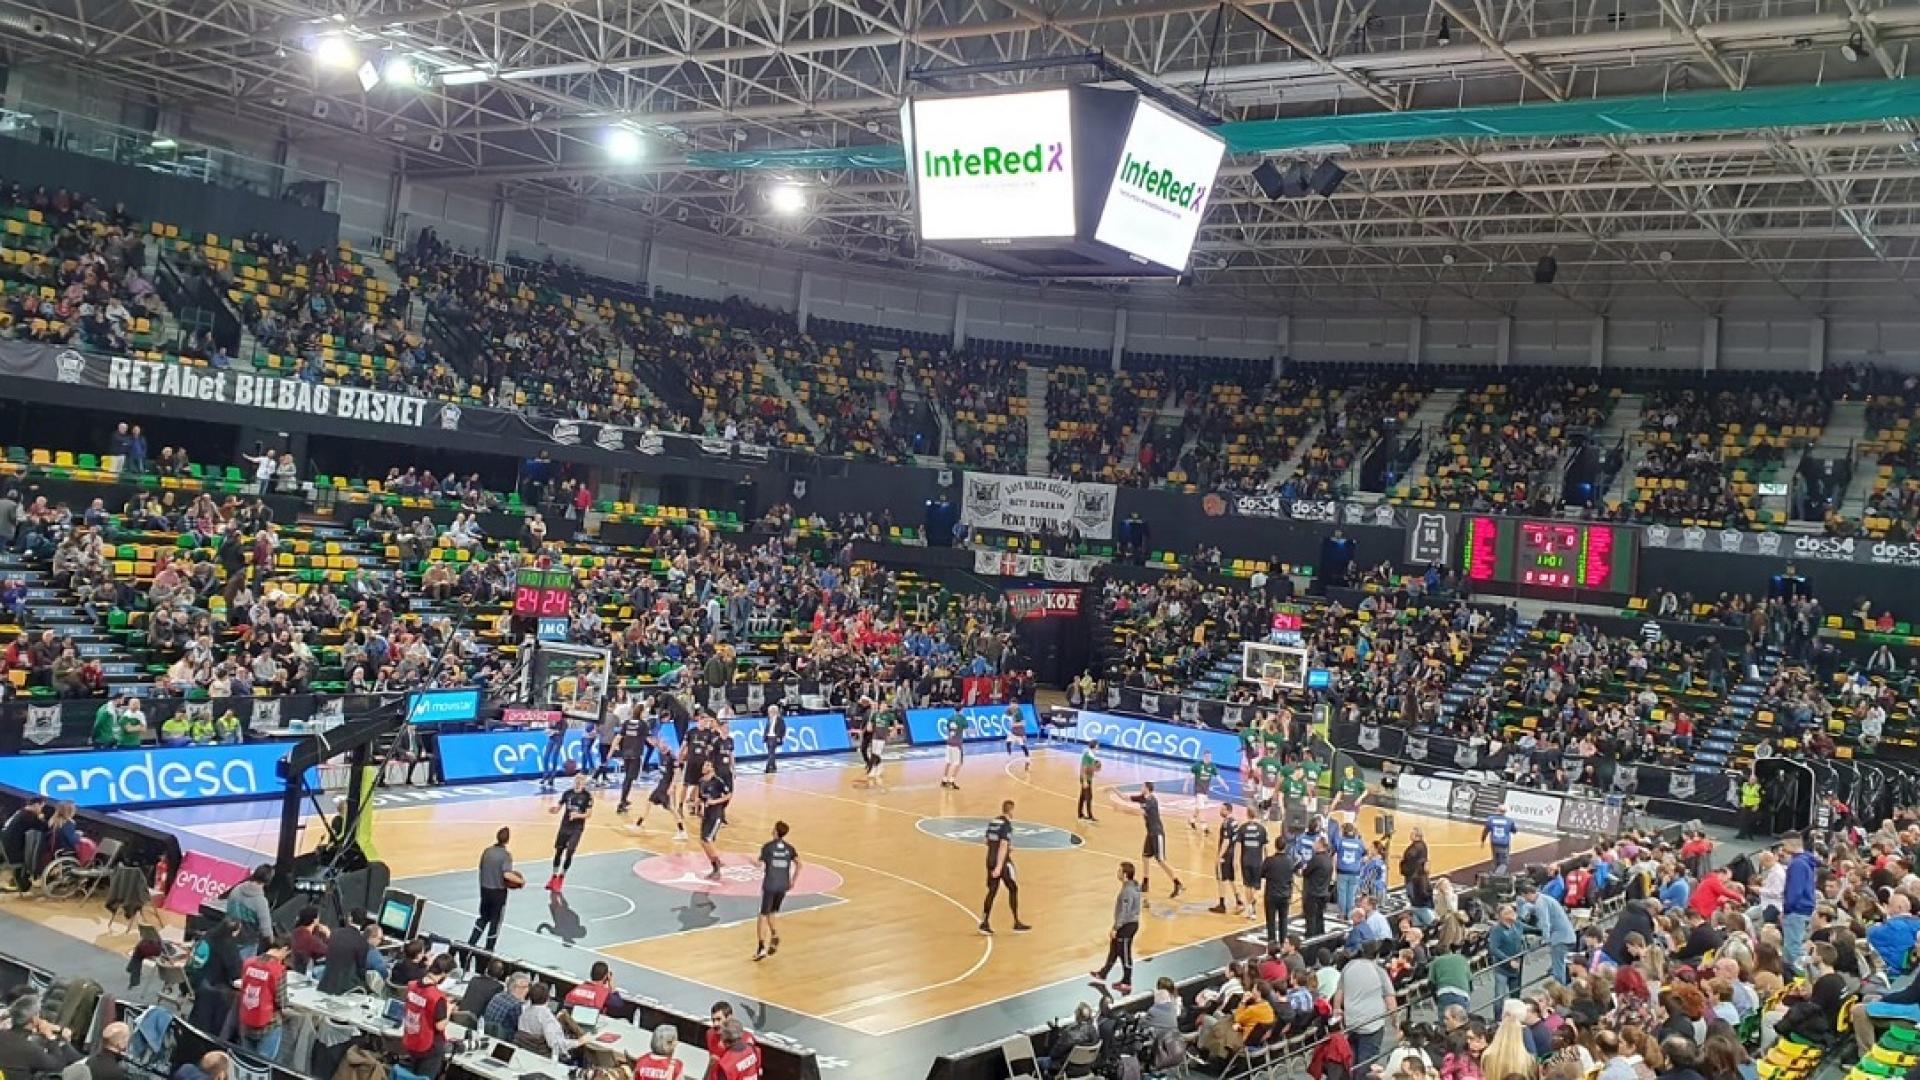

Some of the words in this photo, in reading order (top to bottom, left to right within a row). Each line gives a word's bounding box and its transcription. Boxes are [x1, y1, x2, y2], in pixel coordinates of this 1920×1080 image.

[924, 143, 1043, 177] InteRed
[1120, 152, 1196, 208] InteRed
[108, 357, 226, 401] RETAbet
[234, 375, 330, 415] BILBAO
[337, 386, 427, 426] BASKET
[1239, 495, 1280, 510] dos54
[1291, 499, 1335, 515] dos54
[1795, 535, 1854, 553] dos54
[516, 587, 539, 611] 24
[542, 590, 567, 614] 24
[539, 624, 567, 634] IMQ
[1274, 612, 1292, 629] 24
[432, 701, 473, 711] movistar
[508, 711, 549, 721] endesa
[1082, 720, 1202, 758] endesa
[39, 752, 257, 803] endesa
